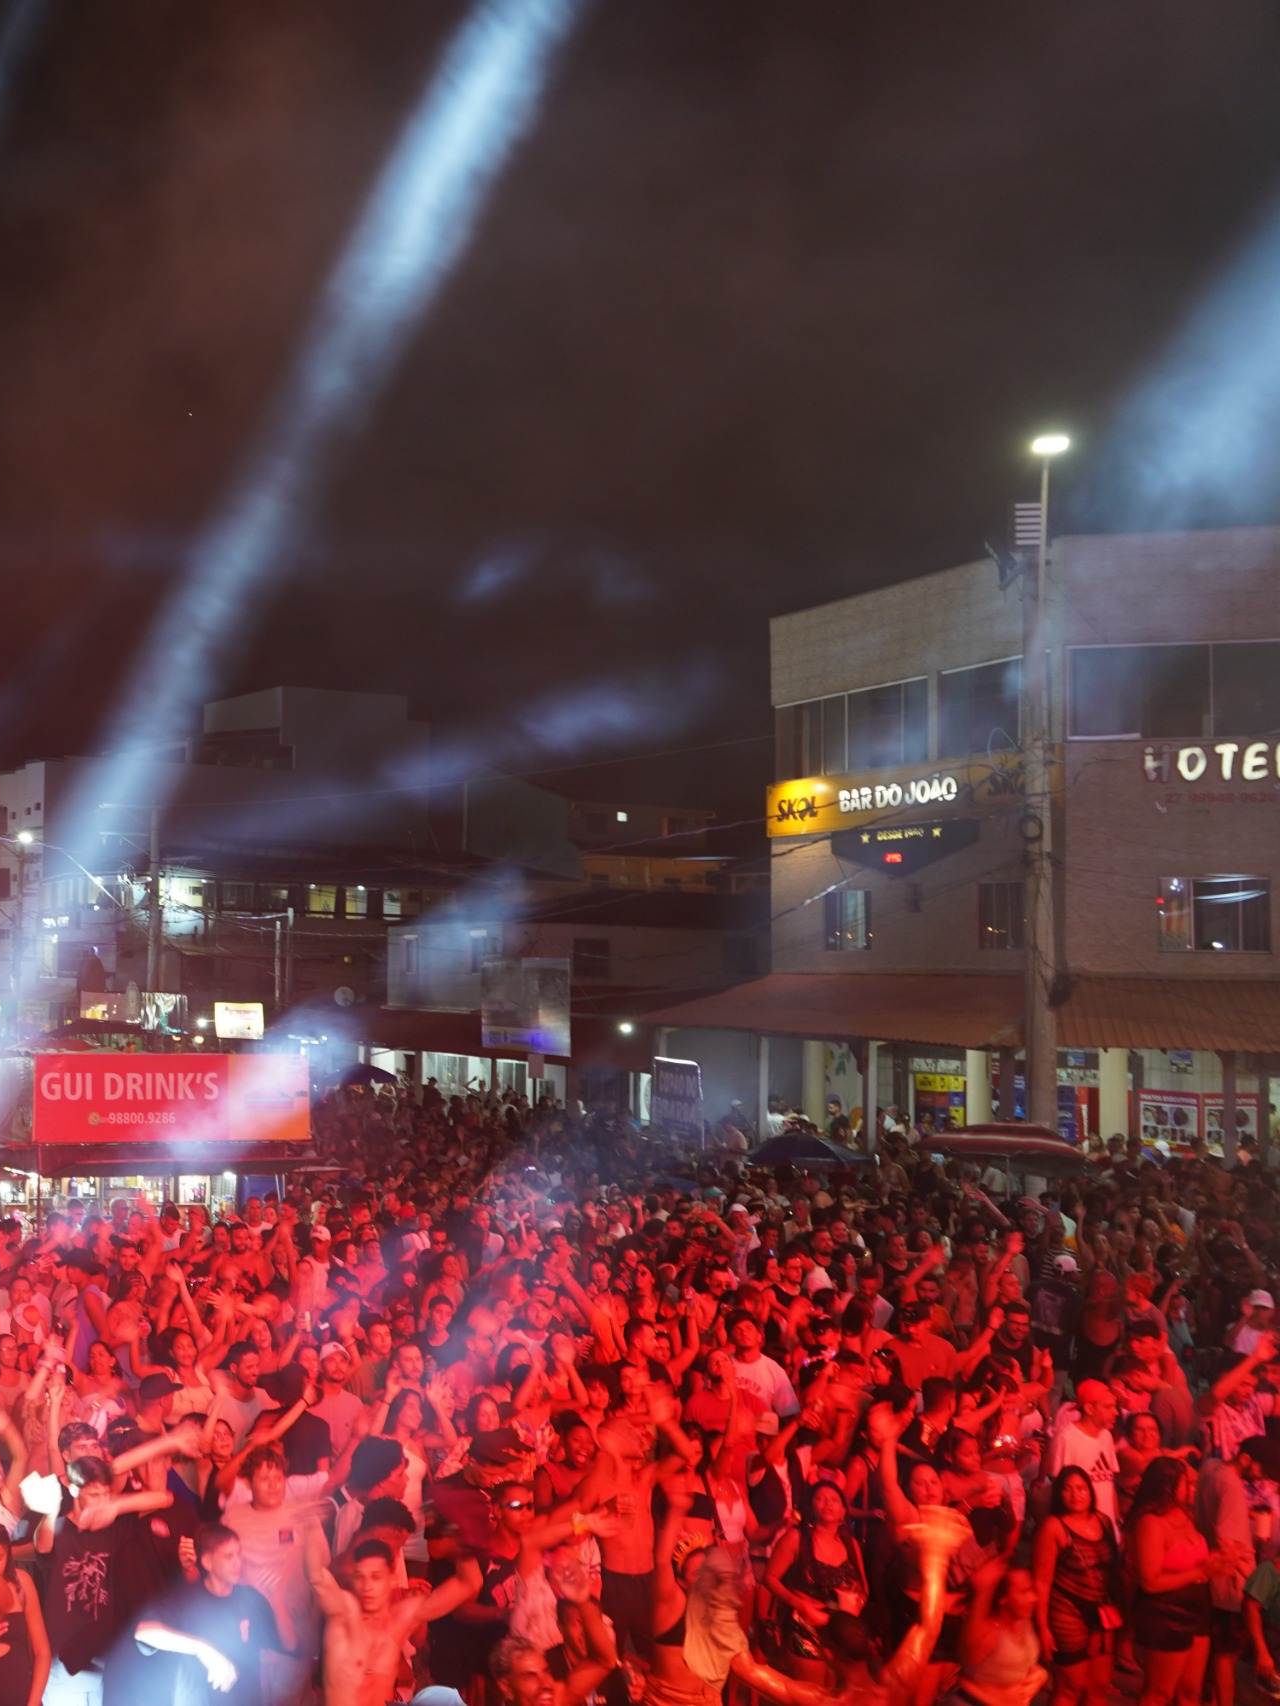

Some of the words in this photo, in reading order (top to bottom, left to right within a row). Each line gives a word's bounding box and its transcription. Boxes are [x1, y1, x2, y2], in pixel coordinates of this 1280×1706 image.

[1144, 743, 1280, 781] HOTE
[777, 796, 819, 822] SKOL
[839, 787, 873, 813] BAR
[876, 784, 902, 809] DO
[904, 774, 958, 805] JOÃO
[40, 1072, 93, 1101] GUI
[104, 1072, 220, 1101] DRINK'S
